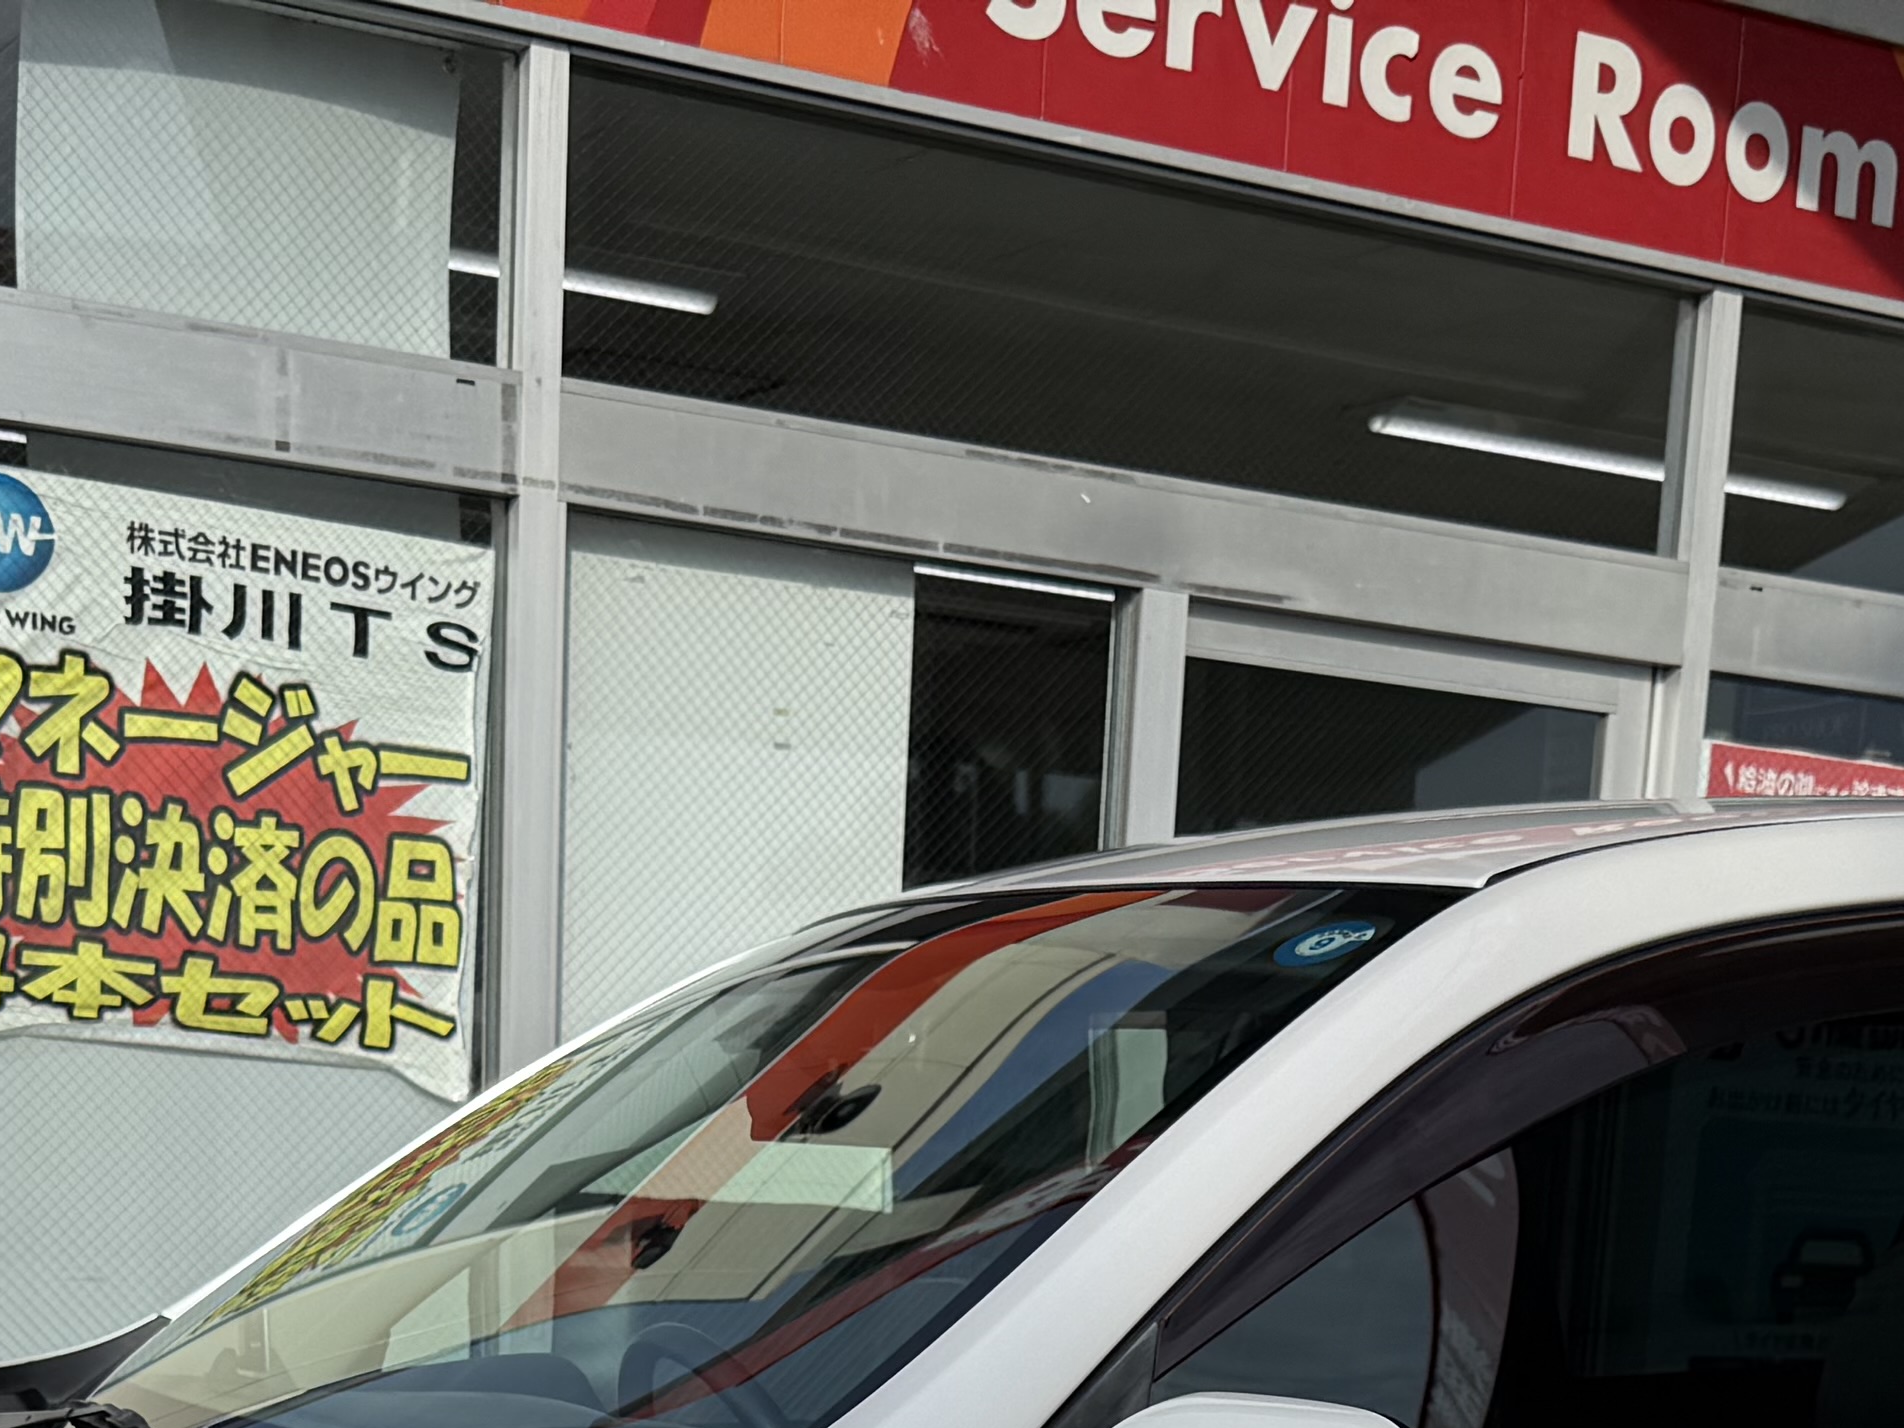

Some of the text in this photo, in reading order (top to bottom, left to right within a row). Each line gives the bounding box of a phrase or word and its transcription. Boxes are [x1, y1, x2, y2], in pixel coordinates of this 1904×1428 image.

[1566, 30, 1900, 229] Room
[125, 520, 481, 609] 株式会社ENEOSウイング
[4, 609, 76, 636] WING
